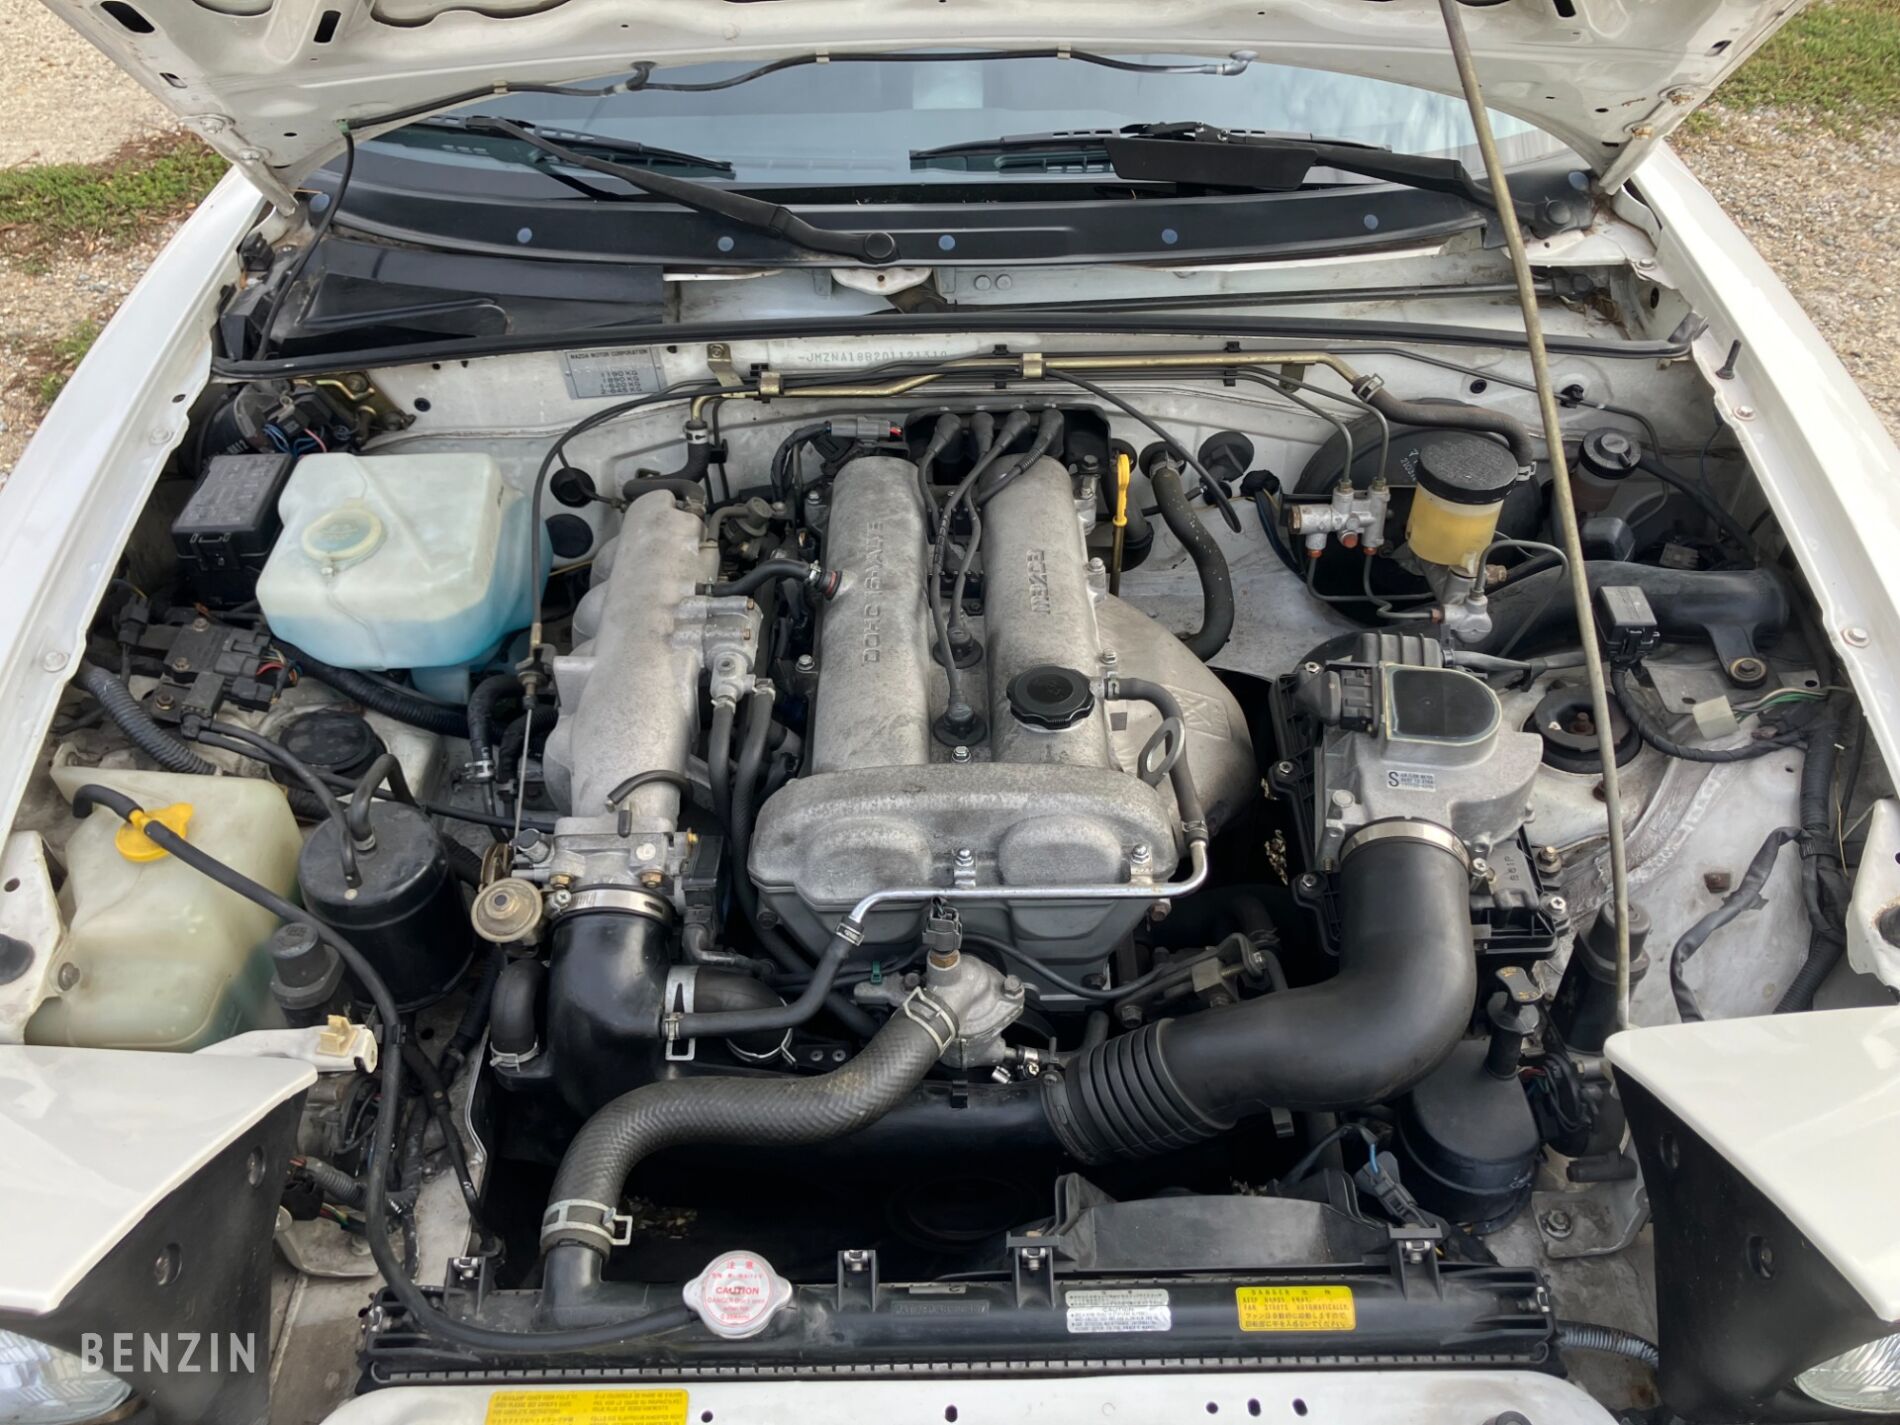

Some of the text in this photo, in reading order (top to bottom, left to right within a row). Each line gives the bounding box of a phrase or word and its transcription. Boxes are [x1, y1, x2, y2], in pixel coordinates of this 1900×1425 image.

[610, 349, 648, 357] CORPORATION
[863, 603, 881, 664] DOHC
[1388, 771, 1400, 787] S
[716, 1287, 759, 1295] CAUTION
